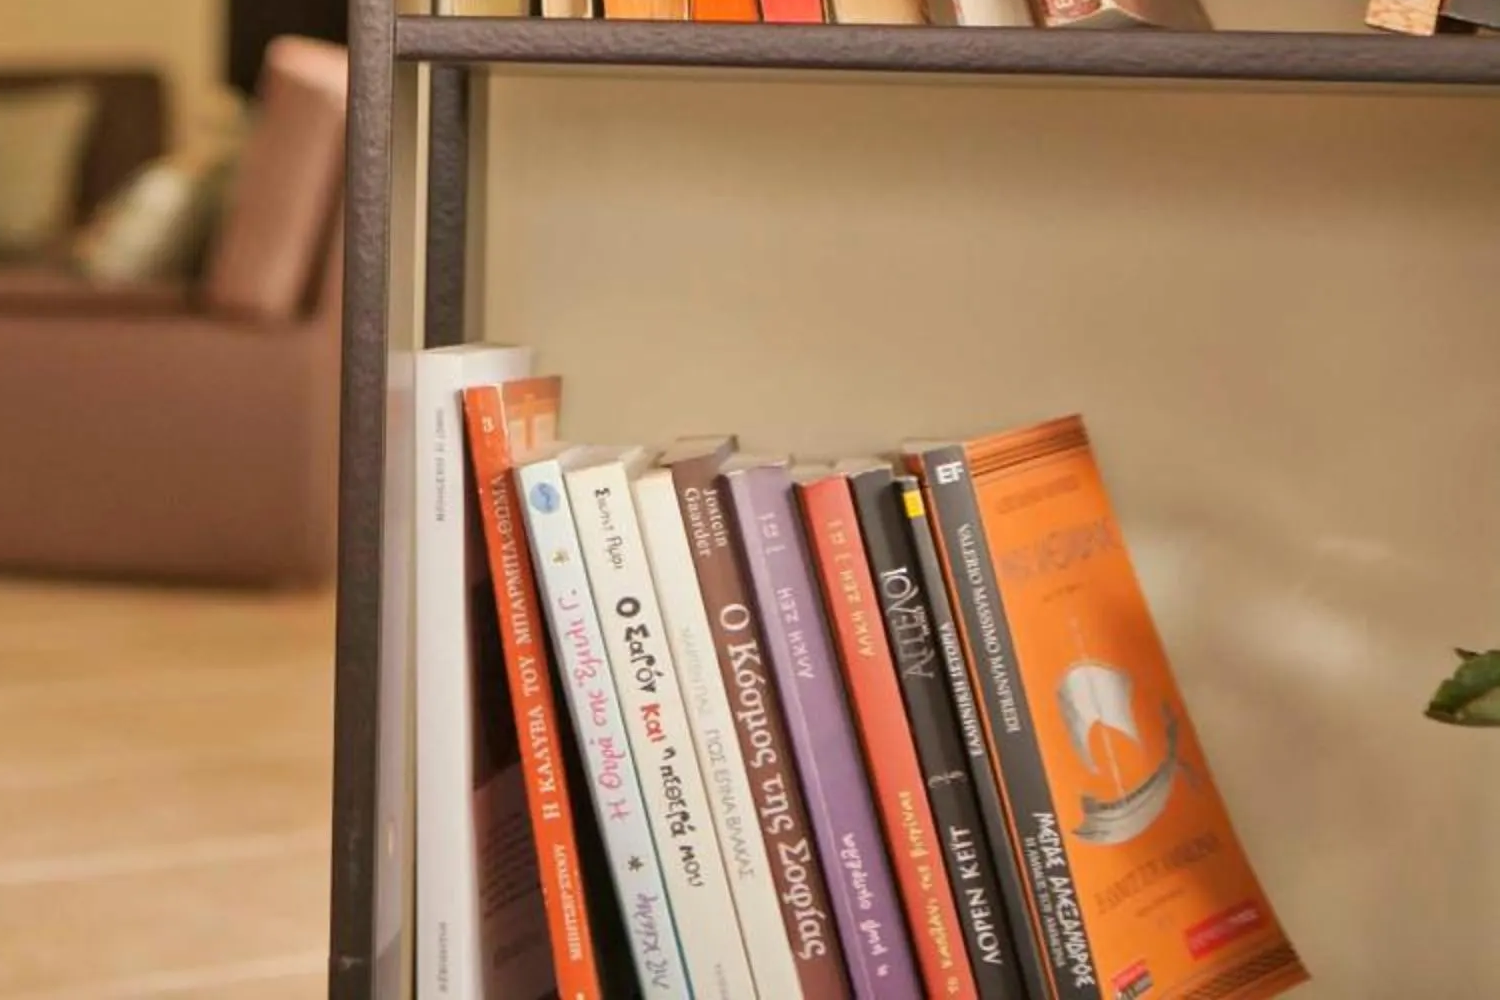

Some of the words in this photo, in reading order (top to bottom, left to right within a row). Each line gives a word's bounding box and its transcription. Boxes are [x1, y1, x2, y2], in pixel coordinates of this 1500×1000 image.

[684, 487, 711, 557] Gaarder
[703, 488, 728, 548] Jostein
[616, 597, 641, 618] Ο
[776, 587, 799, 623] ΖΕΗ
[839, 569, 861, 604] ΖΕΗ
[720, 603, 750, 631] Ο
[851, 611, 876, 658] ΑΛΚΗ
[957, 523, 983, 585] VALERIO
[972, 585, 1001, 654] MASSIMO
[990, 654, 1022, 734] MANFREDI
[517, 654, 541, 697] ΤΟΥ
[788, 631, 815, 679] ΑΛΚΗ
[727, 640, 778, 769] Κόσμος
[528, 705, 557, 793] ΚΑΛΥΒΑ
[541, 801, 561, 820] Η
[760, 773, 795, 835] της
[778, 838, 827, 960] Σοφίας
[965, 887, 1003, 965] ΛΟΡΕΝ
